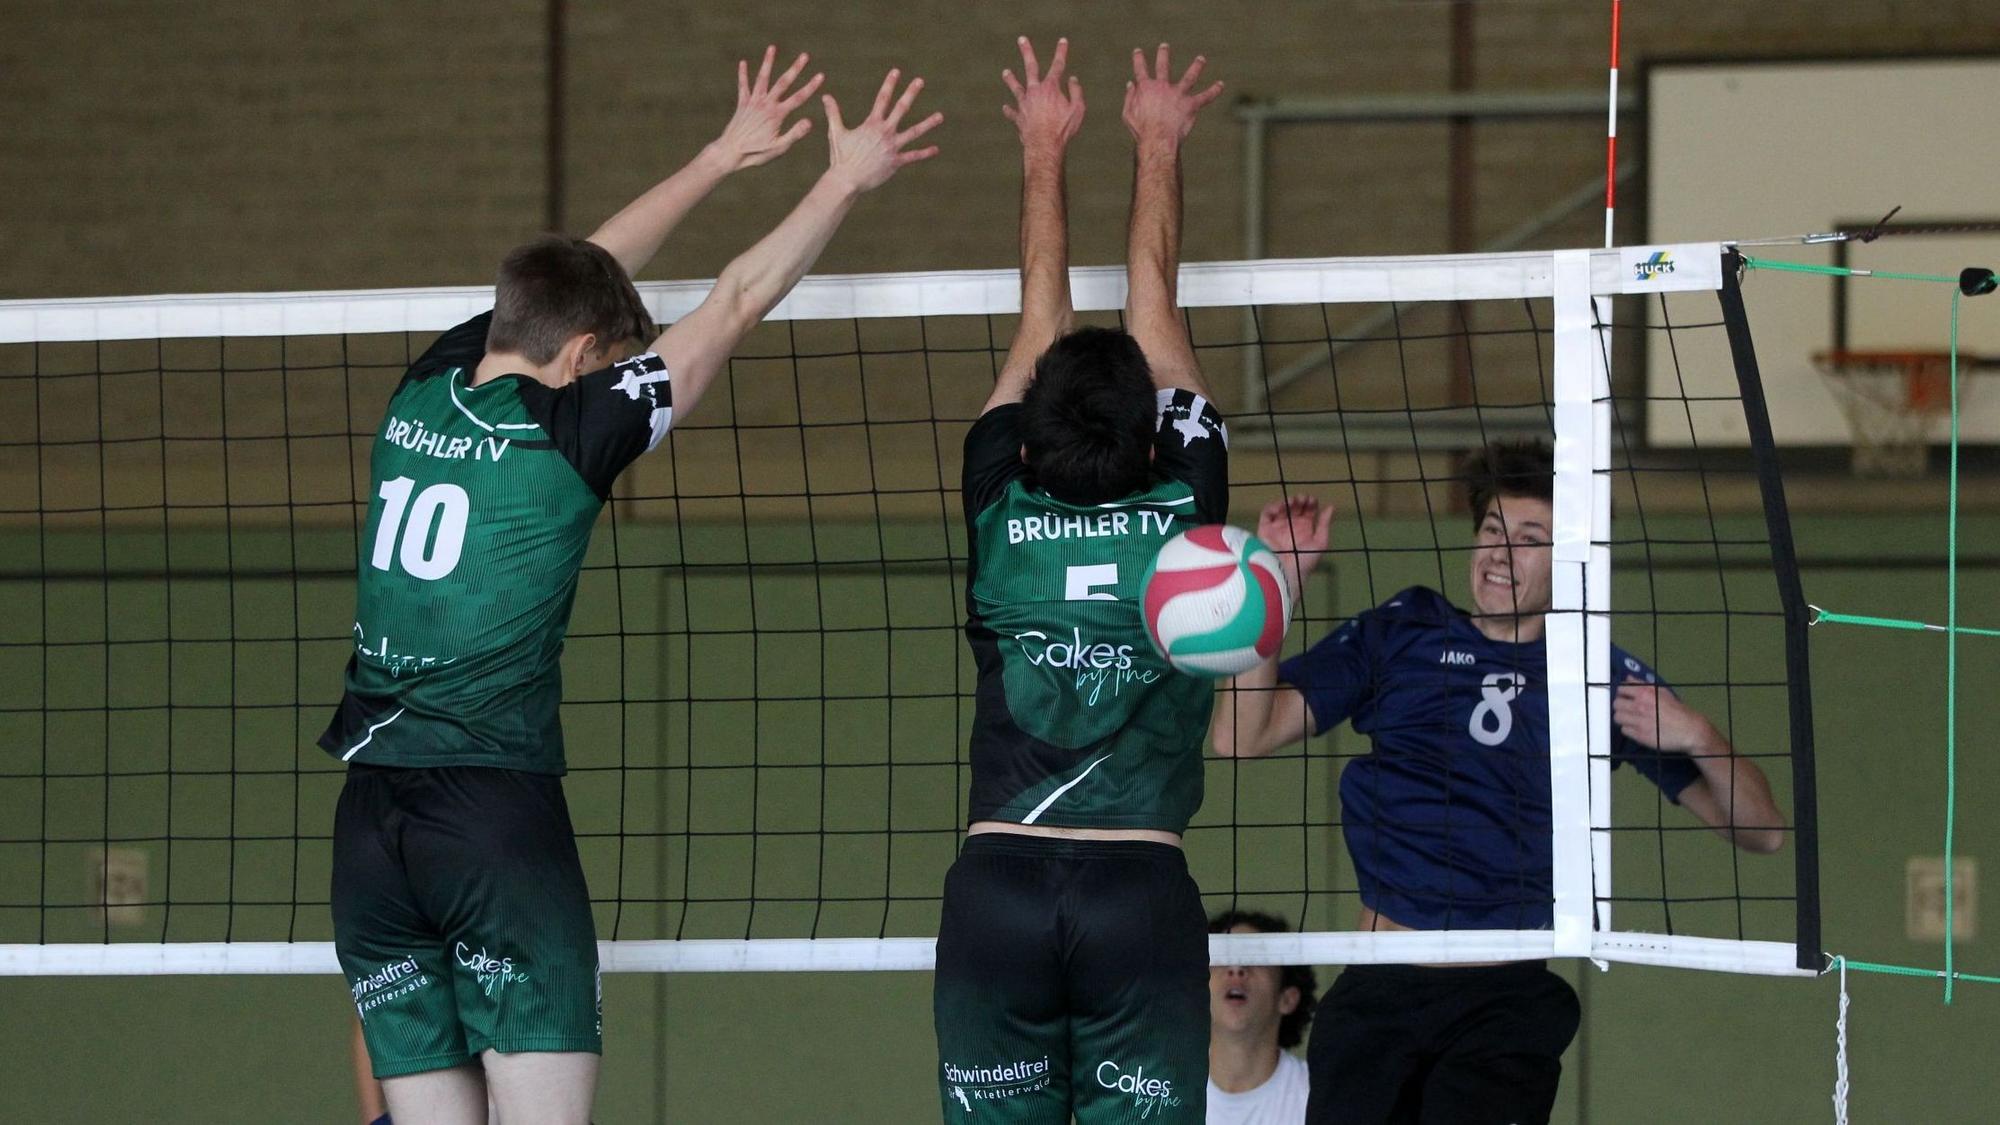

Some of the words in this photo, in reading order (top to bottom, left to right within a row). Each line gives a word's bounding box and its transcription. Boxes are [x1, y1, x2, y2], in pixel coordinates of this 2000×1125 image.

[1633, 260, 1676, 275] HUCK
[385, 416, 473, 459] BRÜHLER
[371, 475, 470, 581] 10
[1007, 511, 1129, 545] BRÜHLER
[1137, 510, 1175, 536] TV
[1015, 626, 1133, 670] Cakes
[1439, 650, 1476, 665] JAKO
[1468, 672, 1527, 747] 8
[944, 1055, 1049, 1083] Schwindelfrei
[1096, 1060, 1172, 1098] Cakes
[974, 1077, 1050, 1100] Kletterwald
